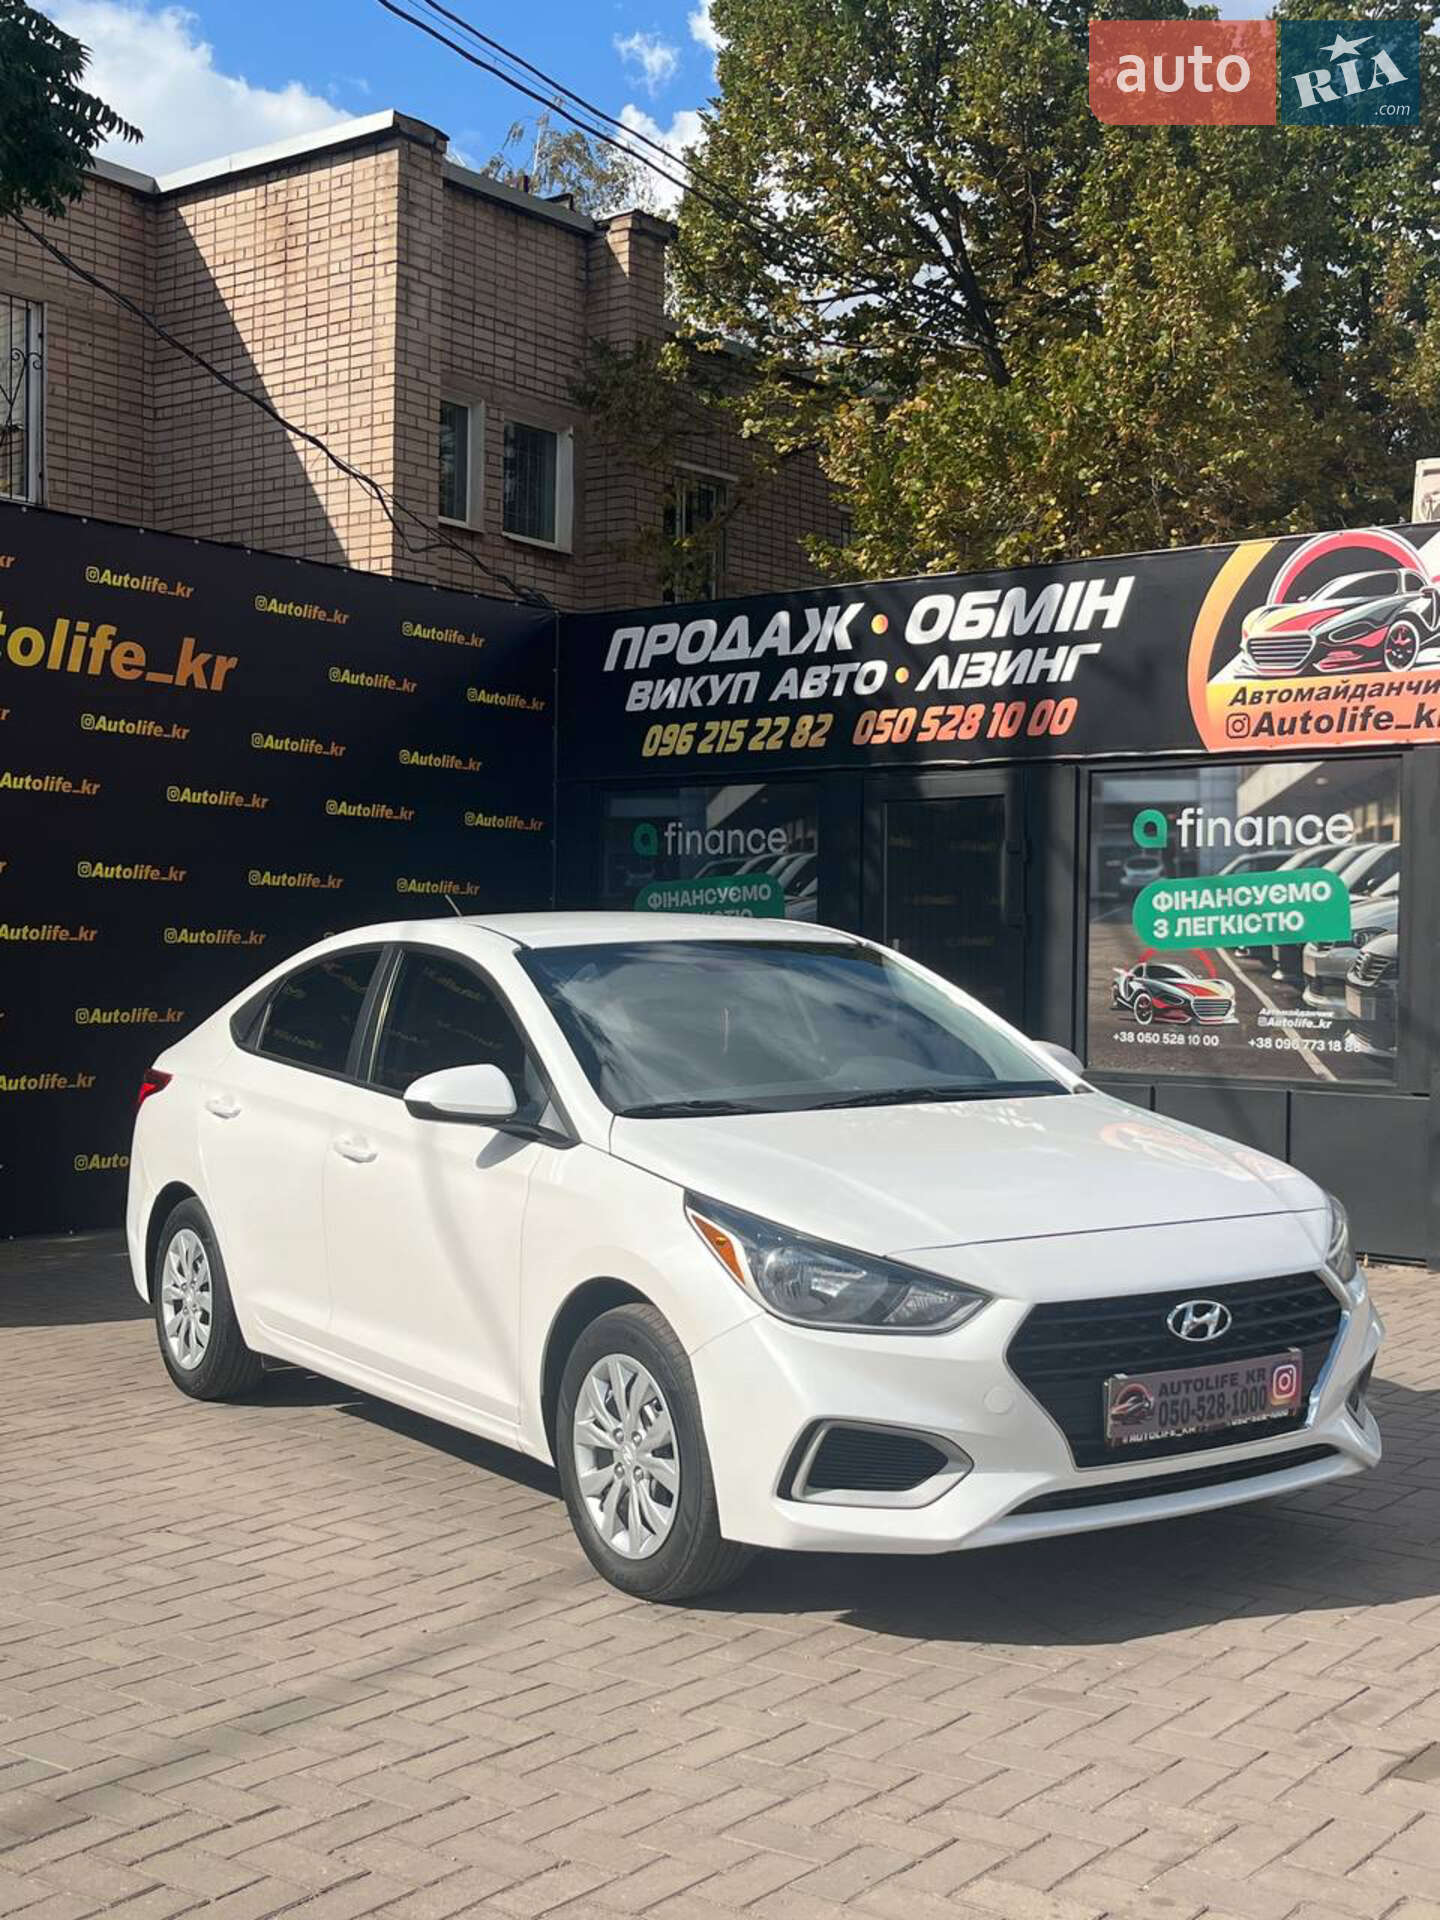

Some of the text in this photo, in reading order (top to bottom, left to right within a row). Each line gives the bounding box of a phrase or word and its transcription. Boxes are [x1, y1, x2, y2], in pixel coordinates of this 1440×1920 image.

[604, 576, 1135, 671] ПРОДАЖ ОБМІН
[0, 610, 239, 691] olife_kr
[625, 643, 1102, 711] ВИКУП АВТО ЛІЗИНГ
[642, 697, 1078, 757] 096 215 22 82 050 528 10 00
[1252, 703, 1440, 738] Autolife_k
[664, 822, 788, 856] finance
[1176, 808, 1354, 848] finance
[647, 883, 772, 910] ФІНАНСУЄМО
[1151, 880, 1333, 913] ФІНАНСУЄМО
[1175, 911, 1305, 938] ЛЕГКІСТЮ
[1136, 1032, 1160, 1044] 050
[1162, 1033, 1185, 1045] 528
[1202, 1034, 1220, 1047] 00
[1158, 1367, 1267, 1397] AUTOLIFE KR
[1158, 1386, 1267, 1426] 050-528-1000
